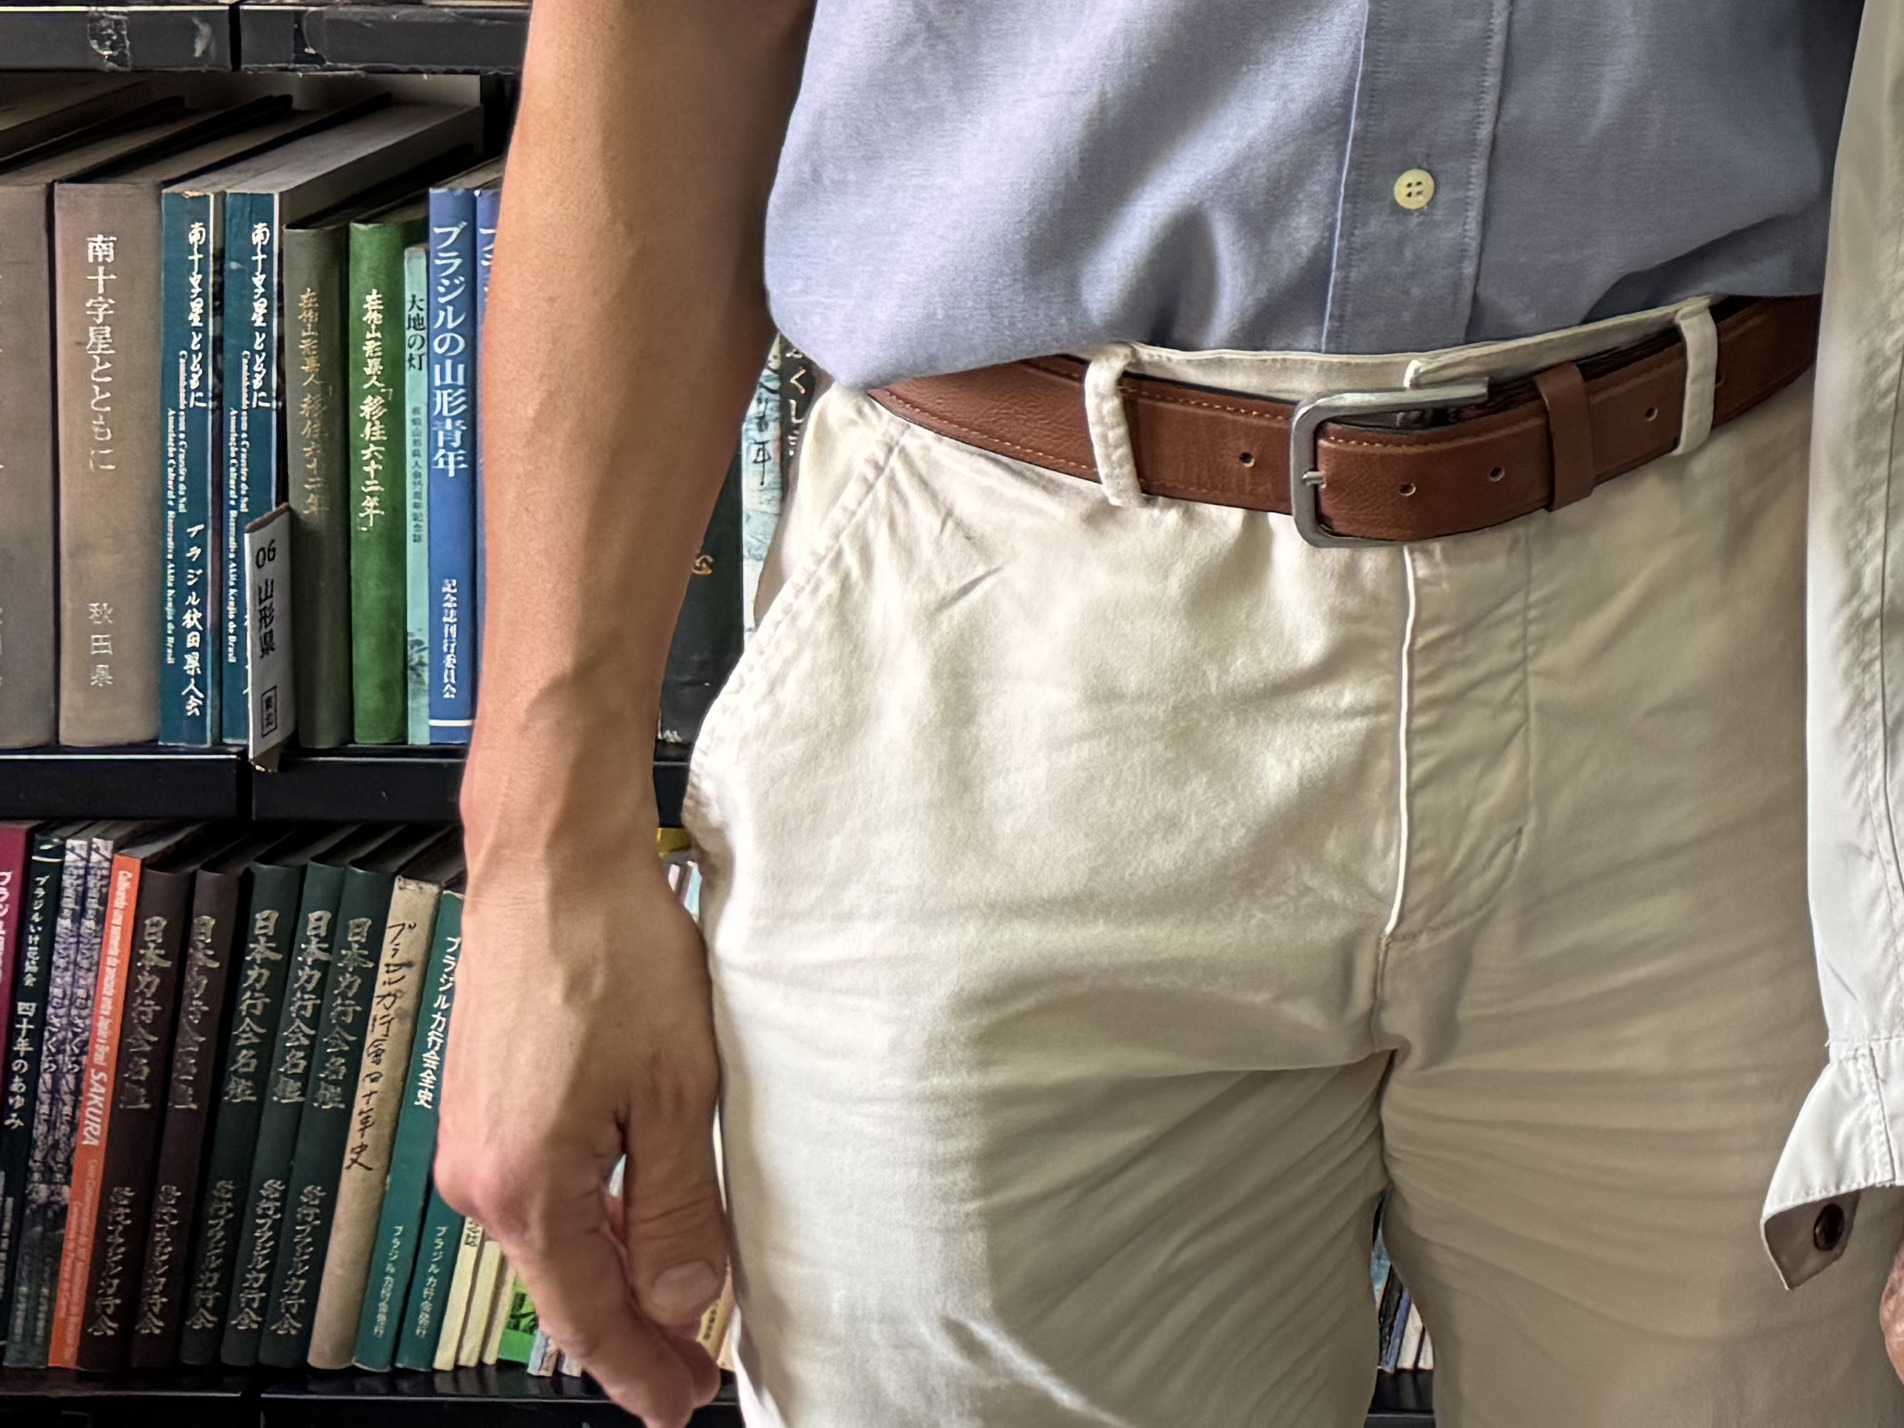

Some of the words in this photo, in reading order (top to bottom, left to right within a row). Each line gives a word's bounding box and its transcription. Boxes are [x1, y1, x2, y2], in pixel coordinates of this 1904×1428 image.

[85, 234, 117, 471] 南十字星とともに
[407, 294, 427, 372] 大地の灯
[431, 224, 470, 479] ブラジルの山形青年
[254, 538, 278, 571] 06
[256, 578, 277, 660] 山形県
[2, 1000, 38, 1131] 四十年のあゆみ
[413, 936, 463, 1111] ブラジル力行会全史
[82, 1068, 108, 1147] SAKURA
